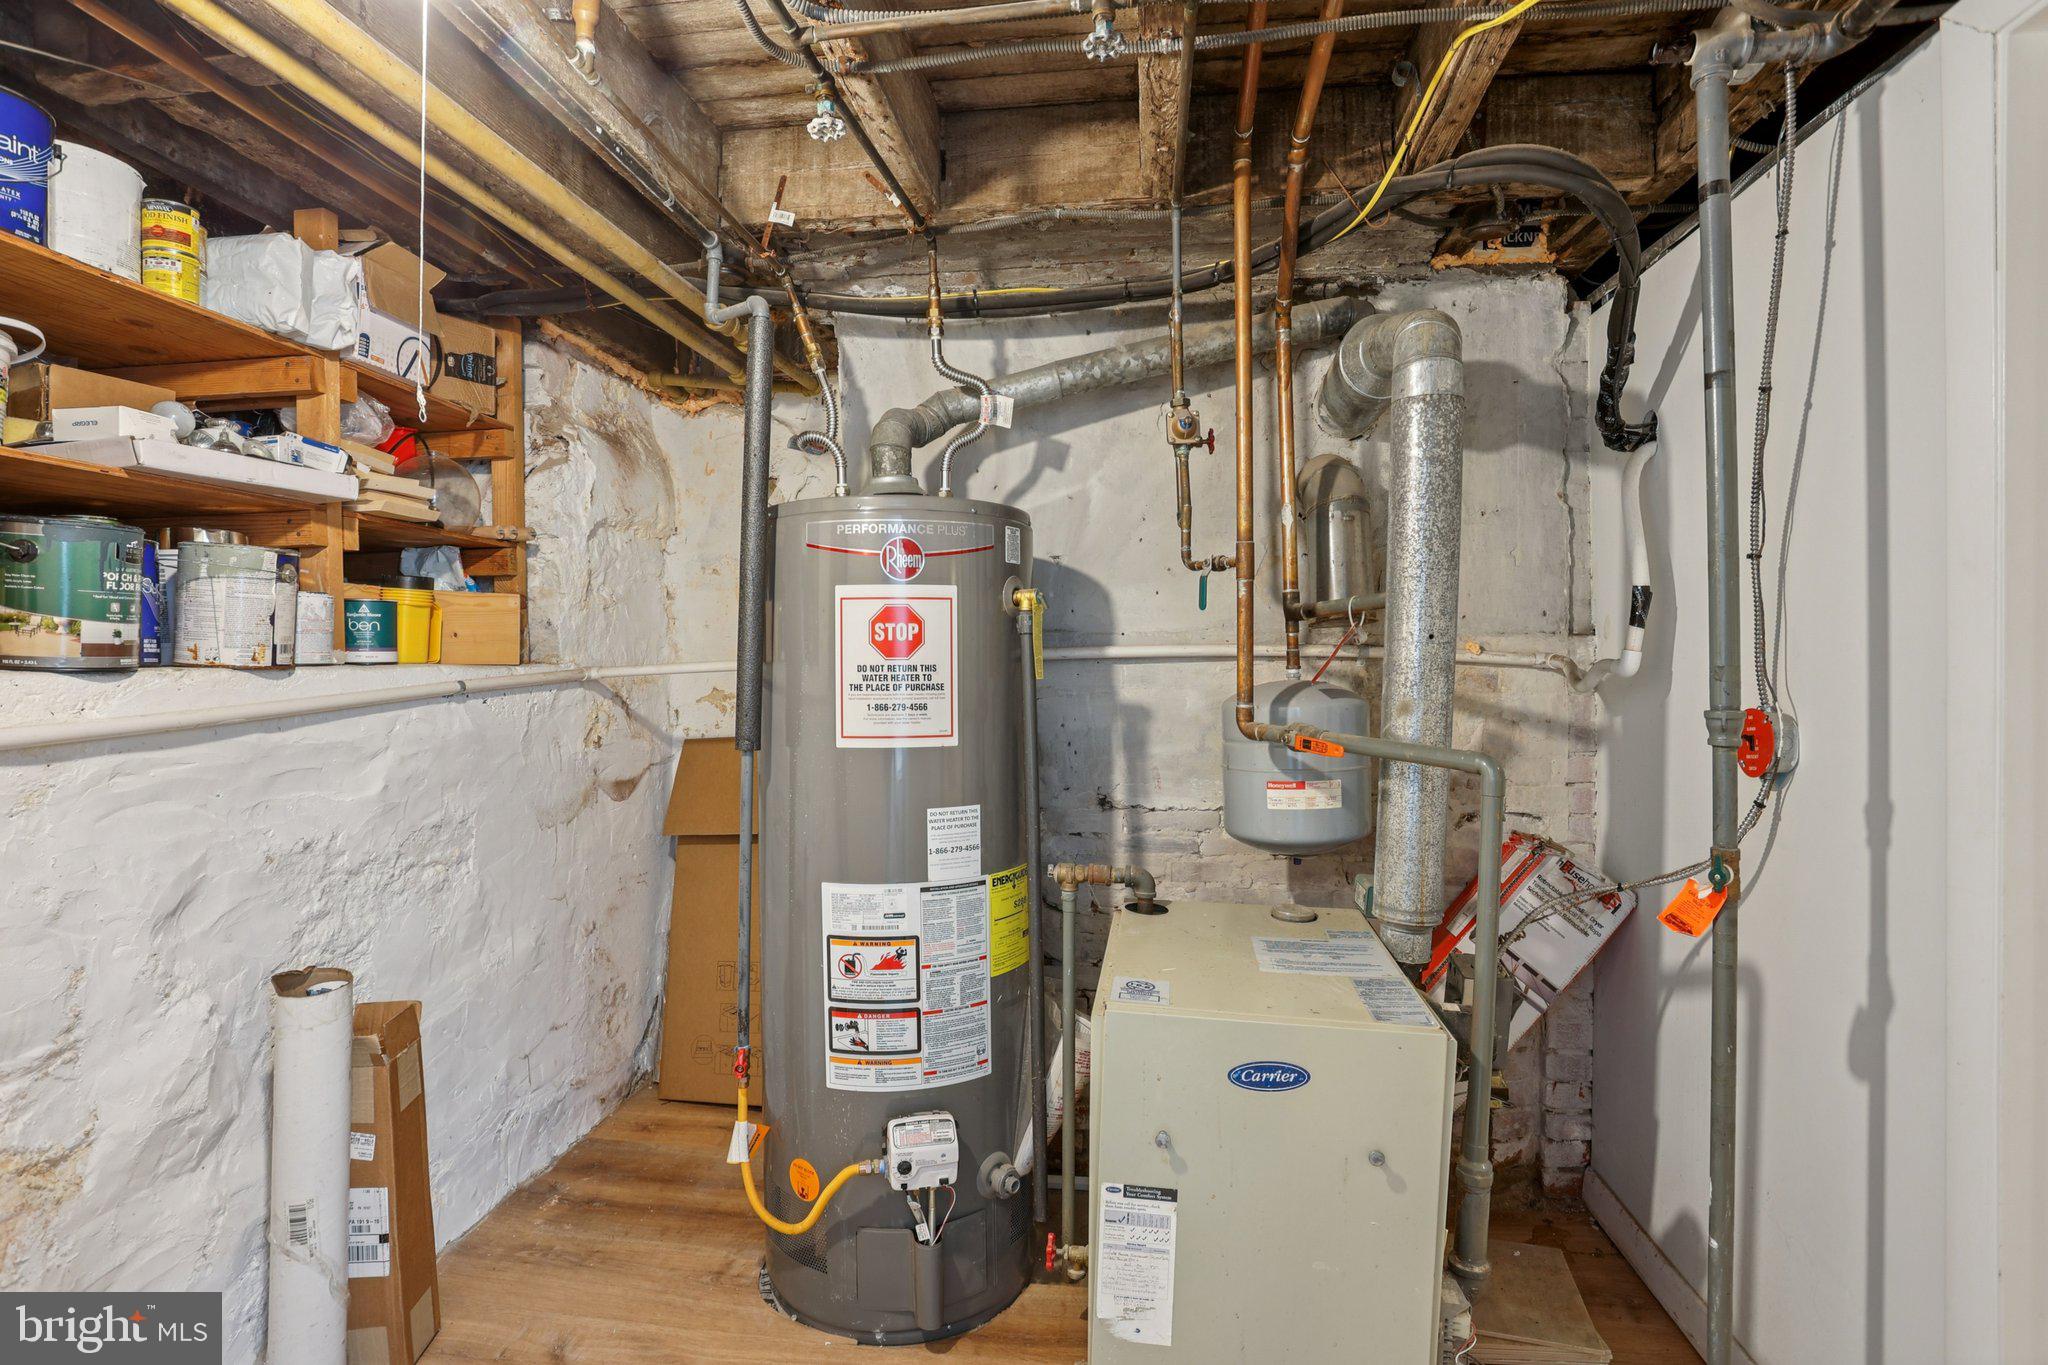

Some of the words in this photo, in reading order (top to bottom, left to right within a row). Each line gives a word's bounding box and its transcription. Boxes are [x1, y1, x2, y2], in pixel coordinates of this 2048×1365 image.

[158, 214, 188, 224] FINISH
[836, 524, 934, 535] PERFORMANCE
[938, 524, 966, 536] PLUS
[886, 538, 921, 574] Rheem
[349, 618, 380, 631] ben
[874, 622, 919, 642] STOP
[857, 664, 868, 672] DO
[905, 683, 945, 691] PURCHASE
[867, 703, 928, 711] 1-866-279-4566
[929, 844, 980, 855] 1-866-279-4566
[1241, 1069, 1298, 1082] Carrier
[1126, 1186, 1161, 1195] Troubleshooting
